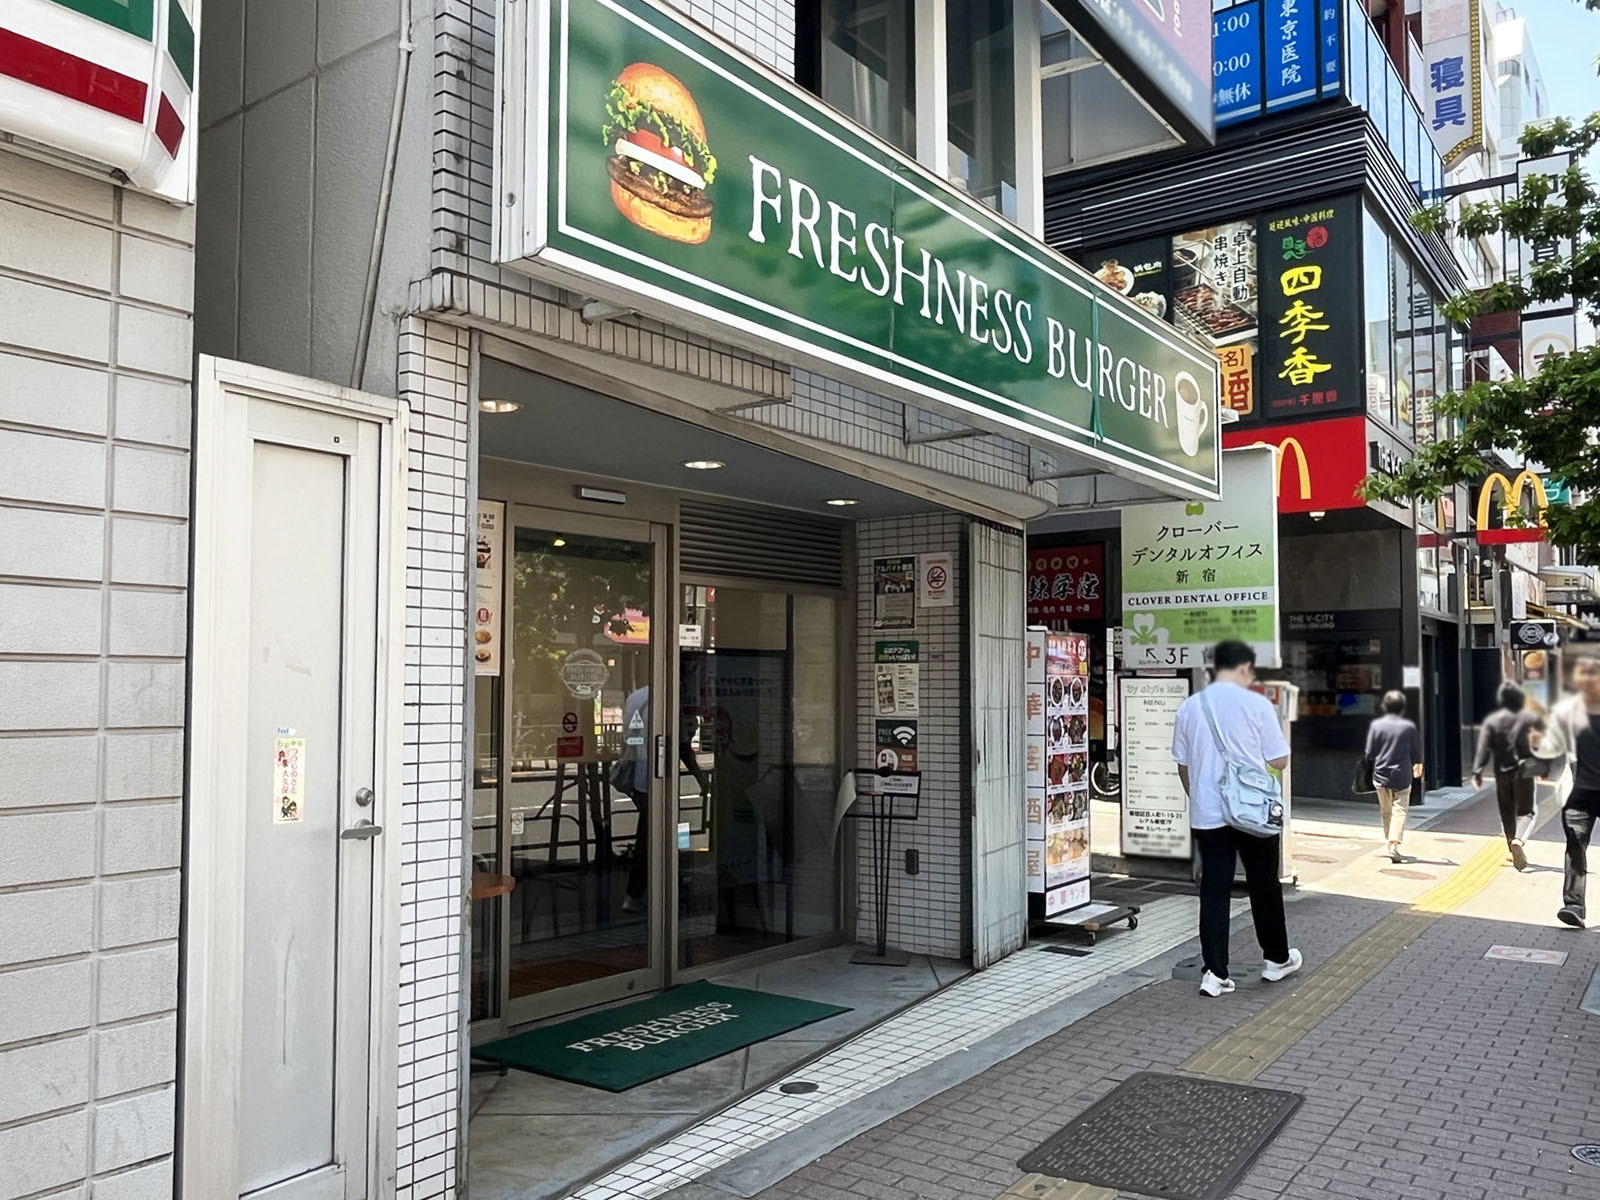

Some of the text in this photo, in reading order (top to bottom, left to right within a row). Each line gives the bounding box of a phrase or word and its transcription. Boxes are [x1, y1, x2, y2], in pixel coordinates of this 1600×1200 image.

[1430, 56, 1467, 131] 寝具
[1213, 236, 1229, 287] 串焼き
[1232, 232, 1248, 301] 卓上自動
[748, 155, 1168, 429] FRESHNESS BURGER
[1278, 265, 1332, 385] 四季香
[1156, 520, 1239, 541] クローバー
[1131, 543, 1263, 566] デンタルオフィス
[1175, 568, 1216, 584] 新宿
[1128, 591, 1269, 606] CLOVER DENTAL OFFICE
[1165, 647, 1189, 664] 3F
[566, 1001, 733, 1052] FRESHNESS
[613, 1012, 739, 1051] BURGER
